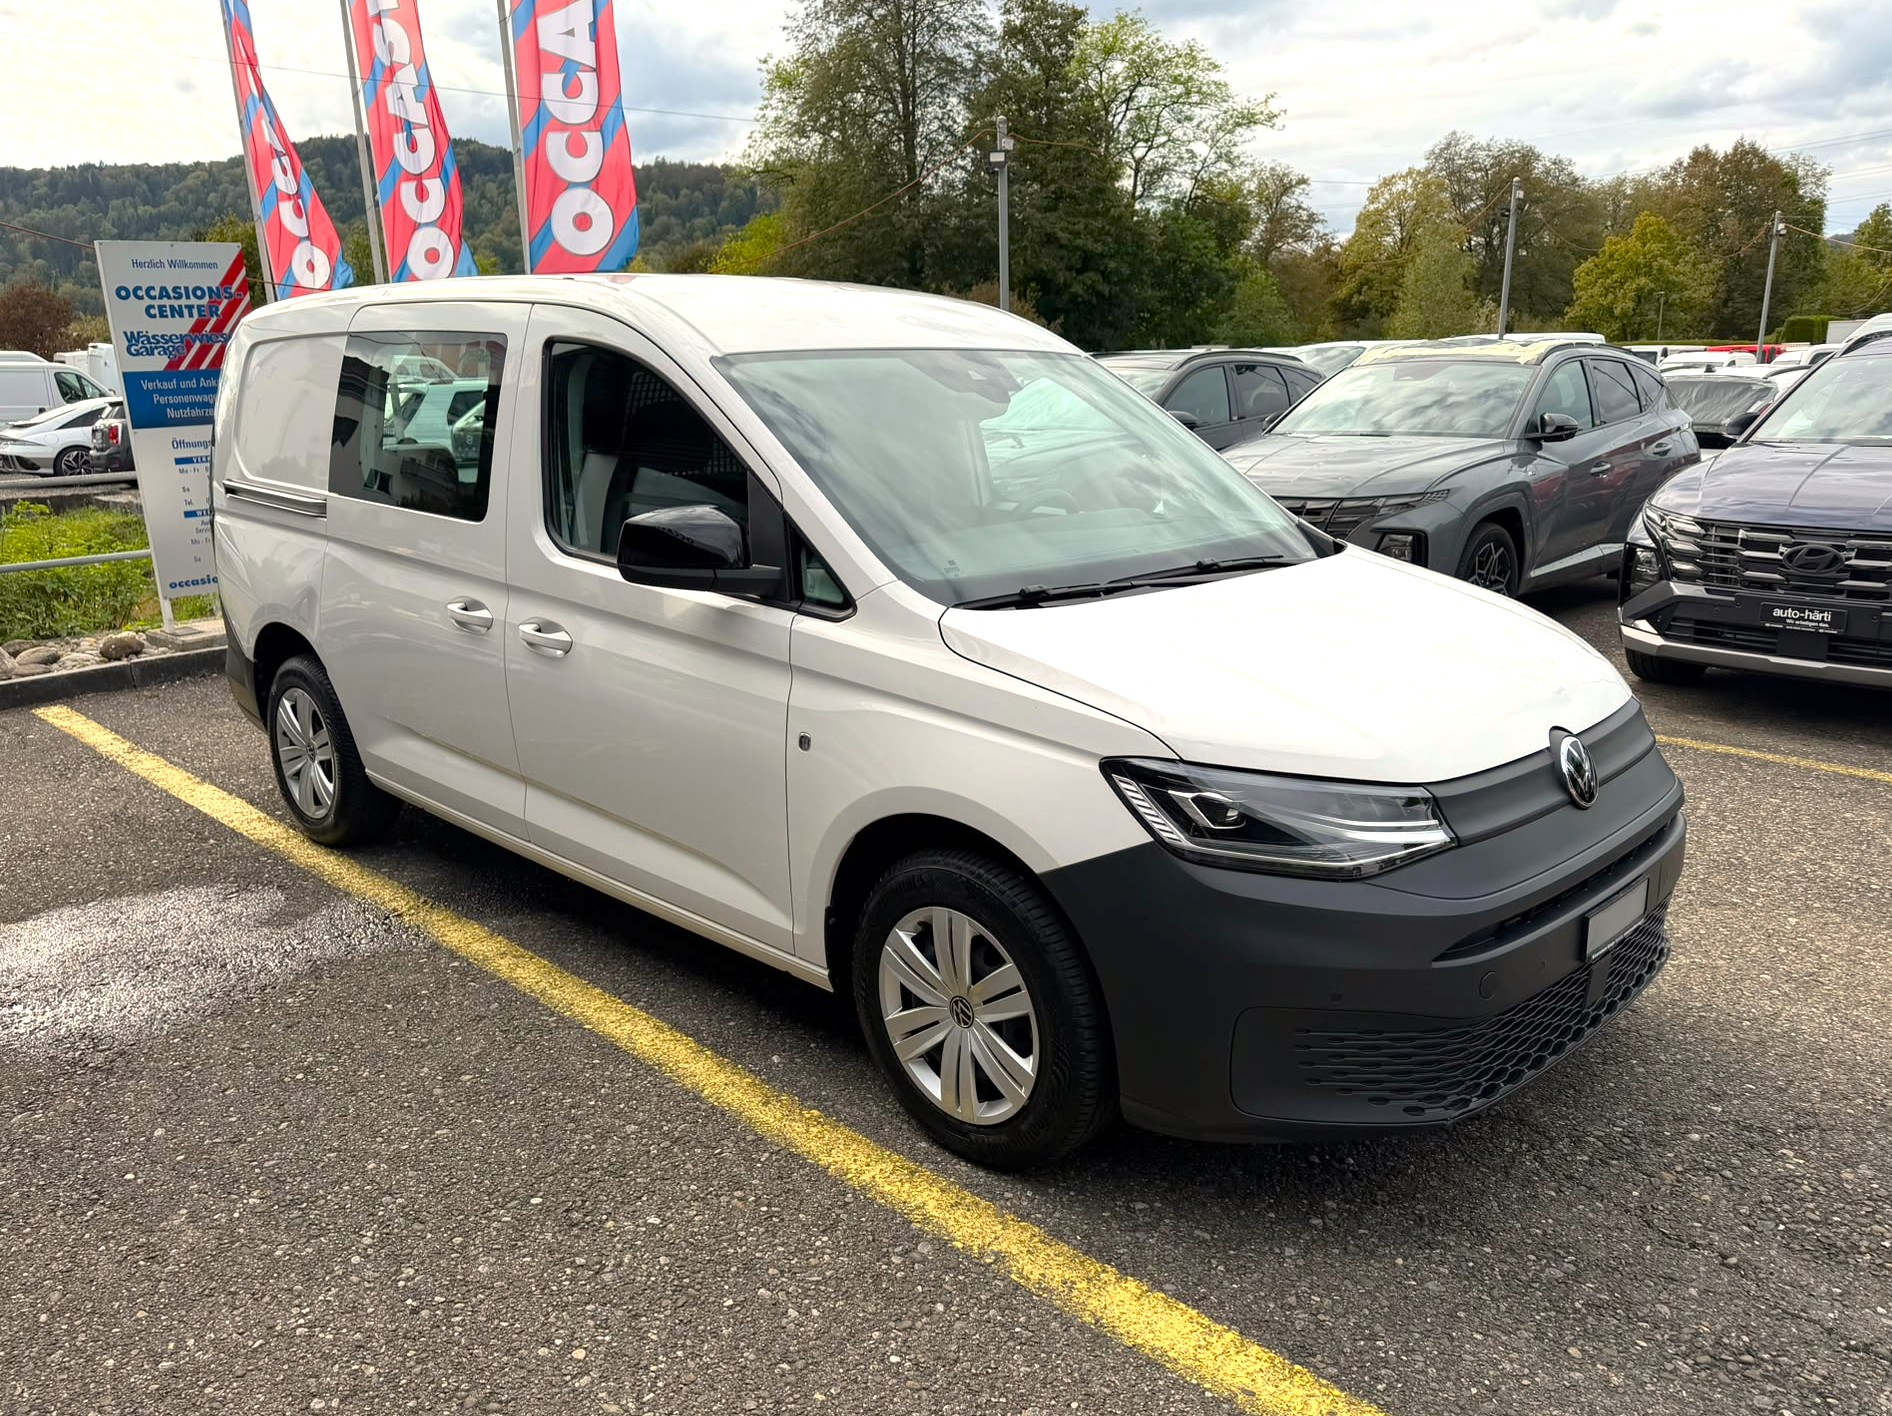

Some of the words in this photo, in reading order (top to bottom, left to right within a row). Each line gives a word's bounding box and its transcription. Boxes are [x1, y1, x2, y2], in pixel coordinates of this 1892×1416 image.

[536, 0, 615, 256] OCCA
[131, 258, 166, 269] Herzlich
[167, 258, 218, 270] Willkommen
[115, 285, 243, 301] OCCASIONS-
[144, 304, 221, 319] CENTER
[126, 343, 187, 360] Garage
[140, 378, 177, 390] Verkauf
[180, 377, 197, 388] und
[200, 377, 219, 387] Ank
[1772, 607, 1832, 622] auto-härti
